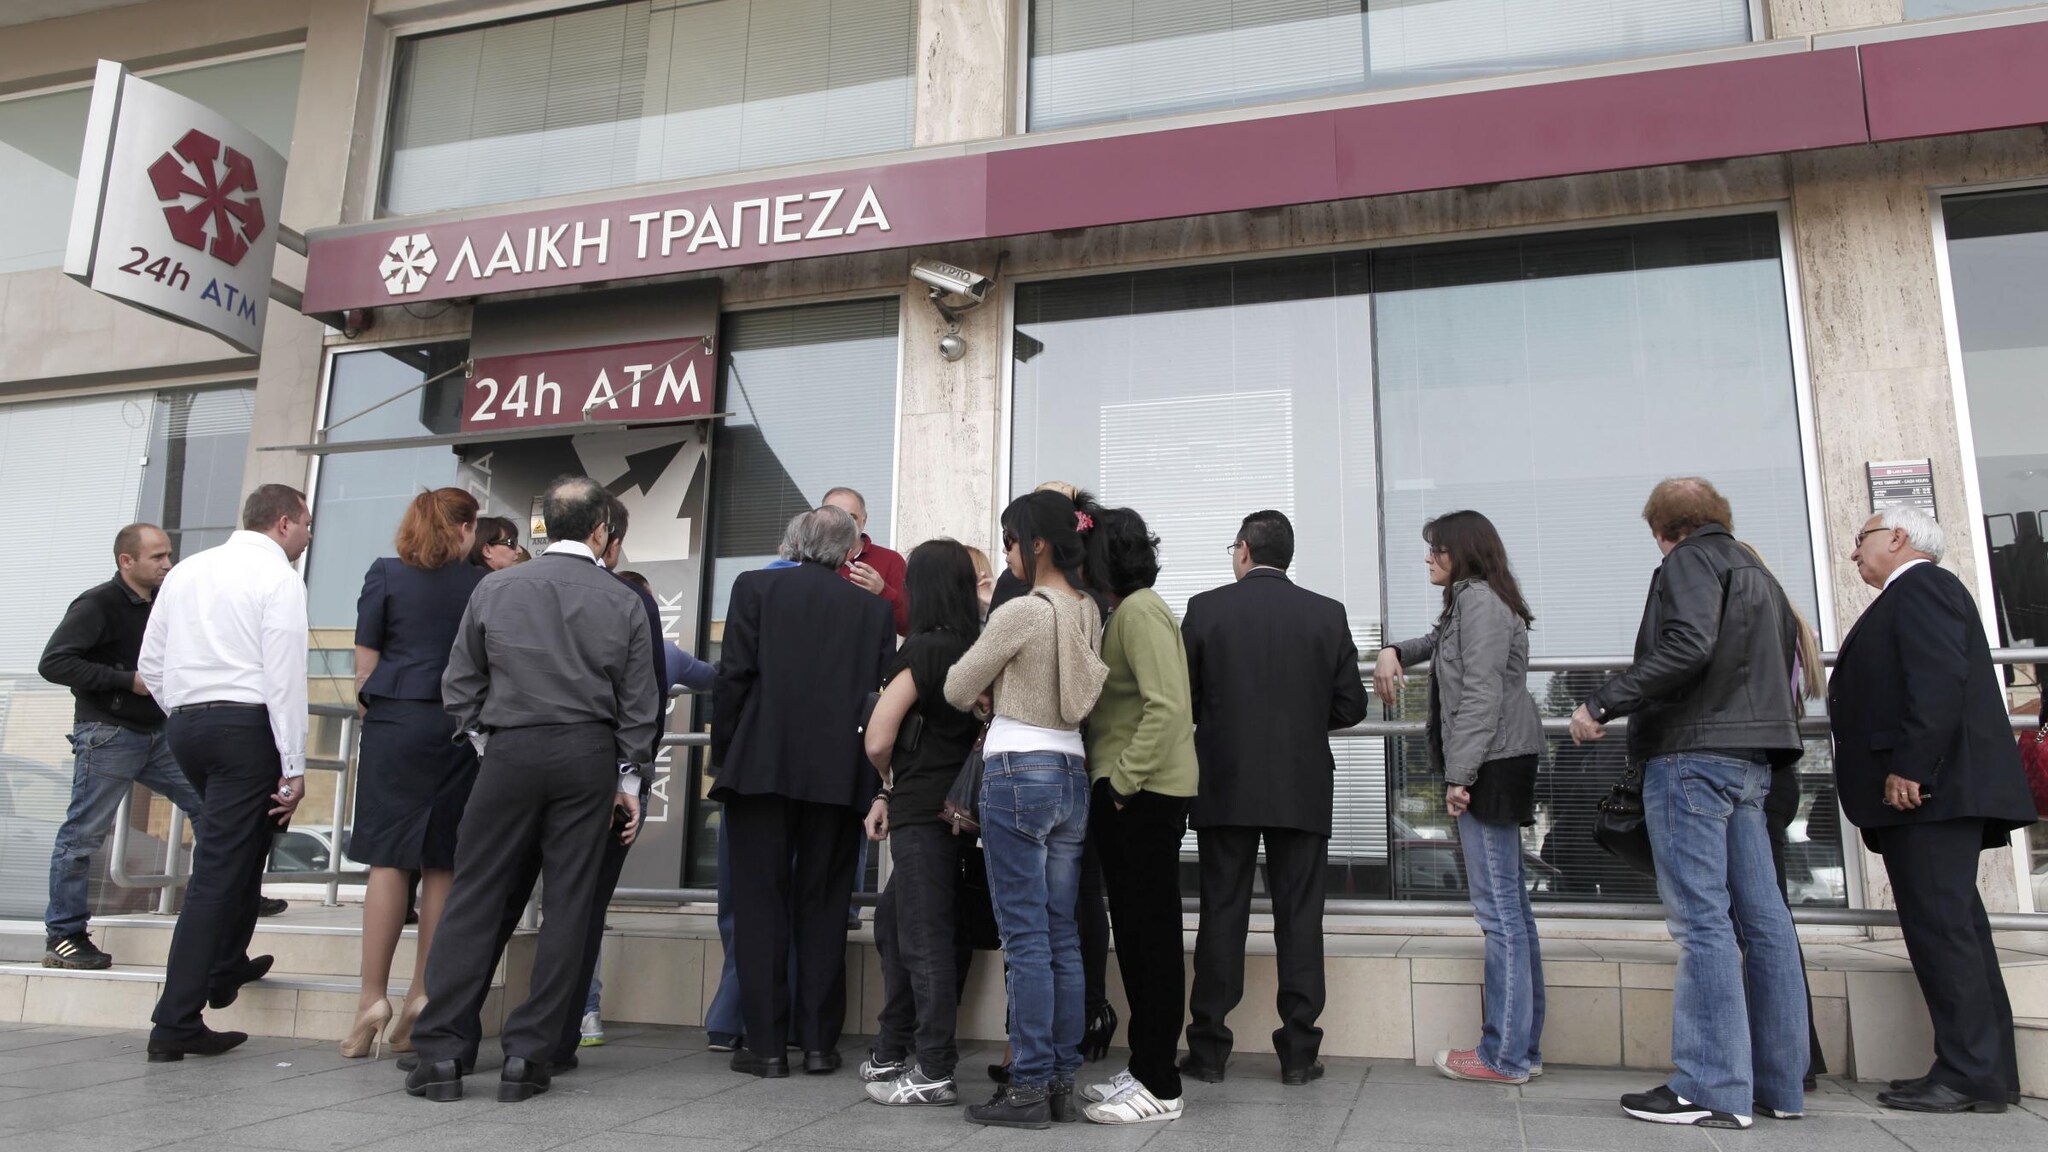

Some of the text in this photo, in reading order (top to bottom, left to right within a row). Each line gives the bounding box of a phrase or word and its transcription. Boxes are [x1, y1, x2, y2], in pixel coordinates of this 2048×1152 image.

[445, 184, 892, 283] ΛΑΙΚΗ ΤΡΑΠΕΖΑ
[118, 246, 257, 327] 24h ATM
[470, 360, 702, 423] 24h ATM
